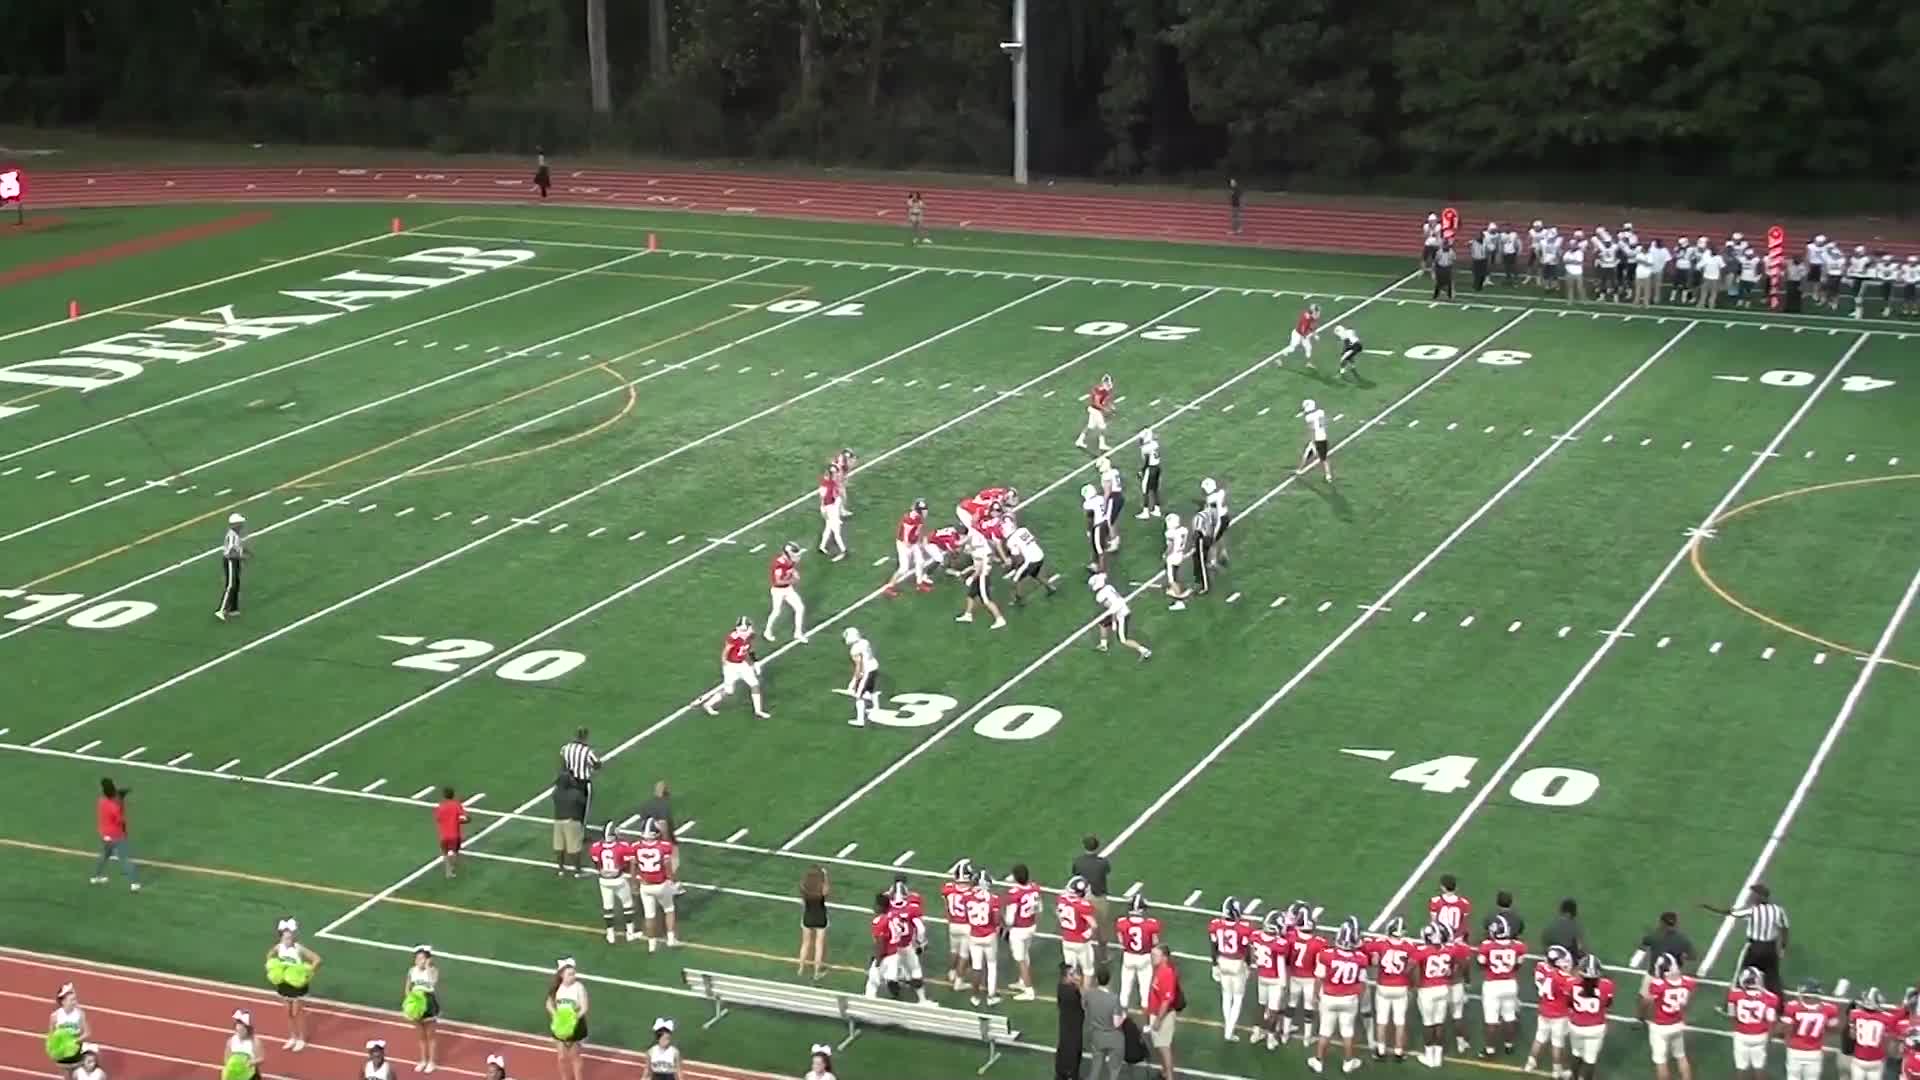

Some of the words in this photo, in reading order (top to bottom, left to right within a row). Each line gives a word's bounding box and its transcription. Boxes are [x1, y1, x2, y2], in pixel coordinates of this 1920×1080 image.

[0, 246, 536, 393] DEKALB
[766, 299, 865, 316] 10
[1073, 321, 1200, 340] 20
[1403, 344, 1533, 366] 30
[1759, 370, 1896, 392] 40
[4, 592, 158, 629] 10
[391, 638, 586, 681] 20
[866, 692, 1063, 740] 30
[1389, 755, 1600, 806] 40
[637, 848, 661, 872] 52
[1128, 926, 1143, 951] 3
[1216, 928, 1238, 954] 13
[1294, 942, 1307, 967] 7
[1381, 949, 1408, 975] 45
[1489, 949, 1516, 974] 59
[1331, 960, 1359, 985] 70
[1736, 999, 1766, 1024] 63
[1795, 1012, 1825, 1038] 77
[1855, 1018, 1884, 1047] 80
